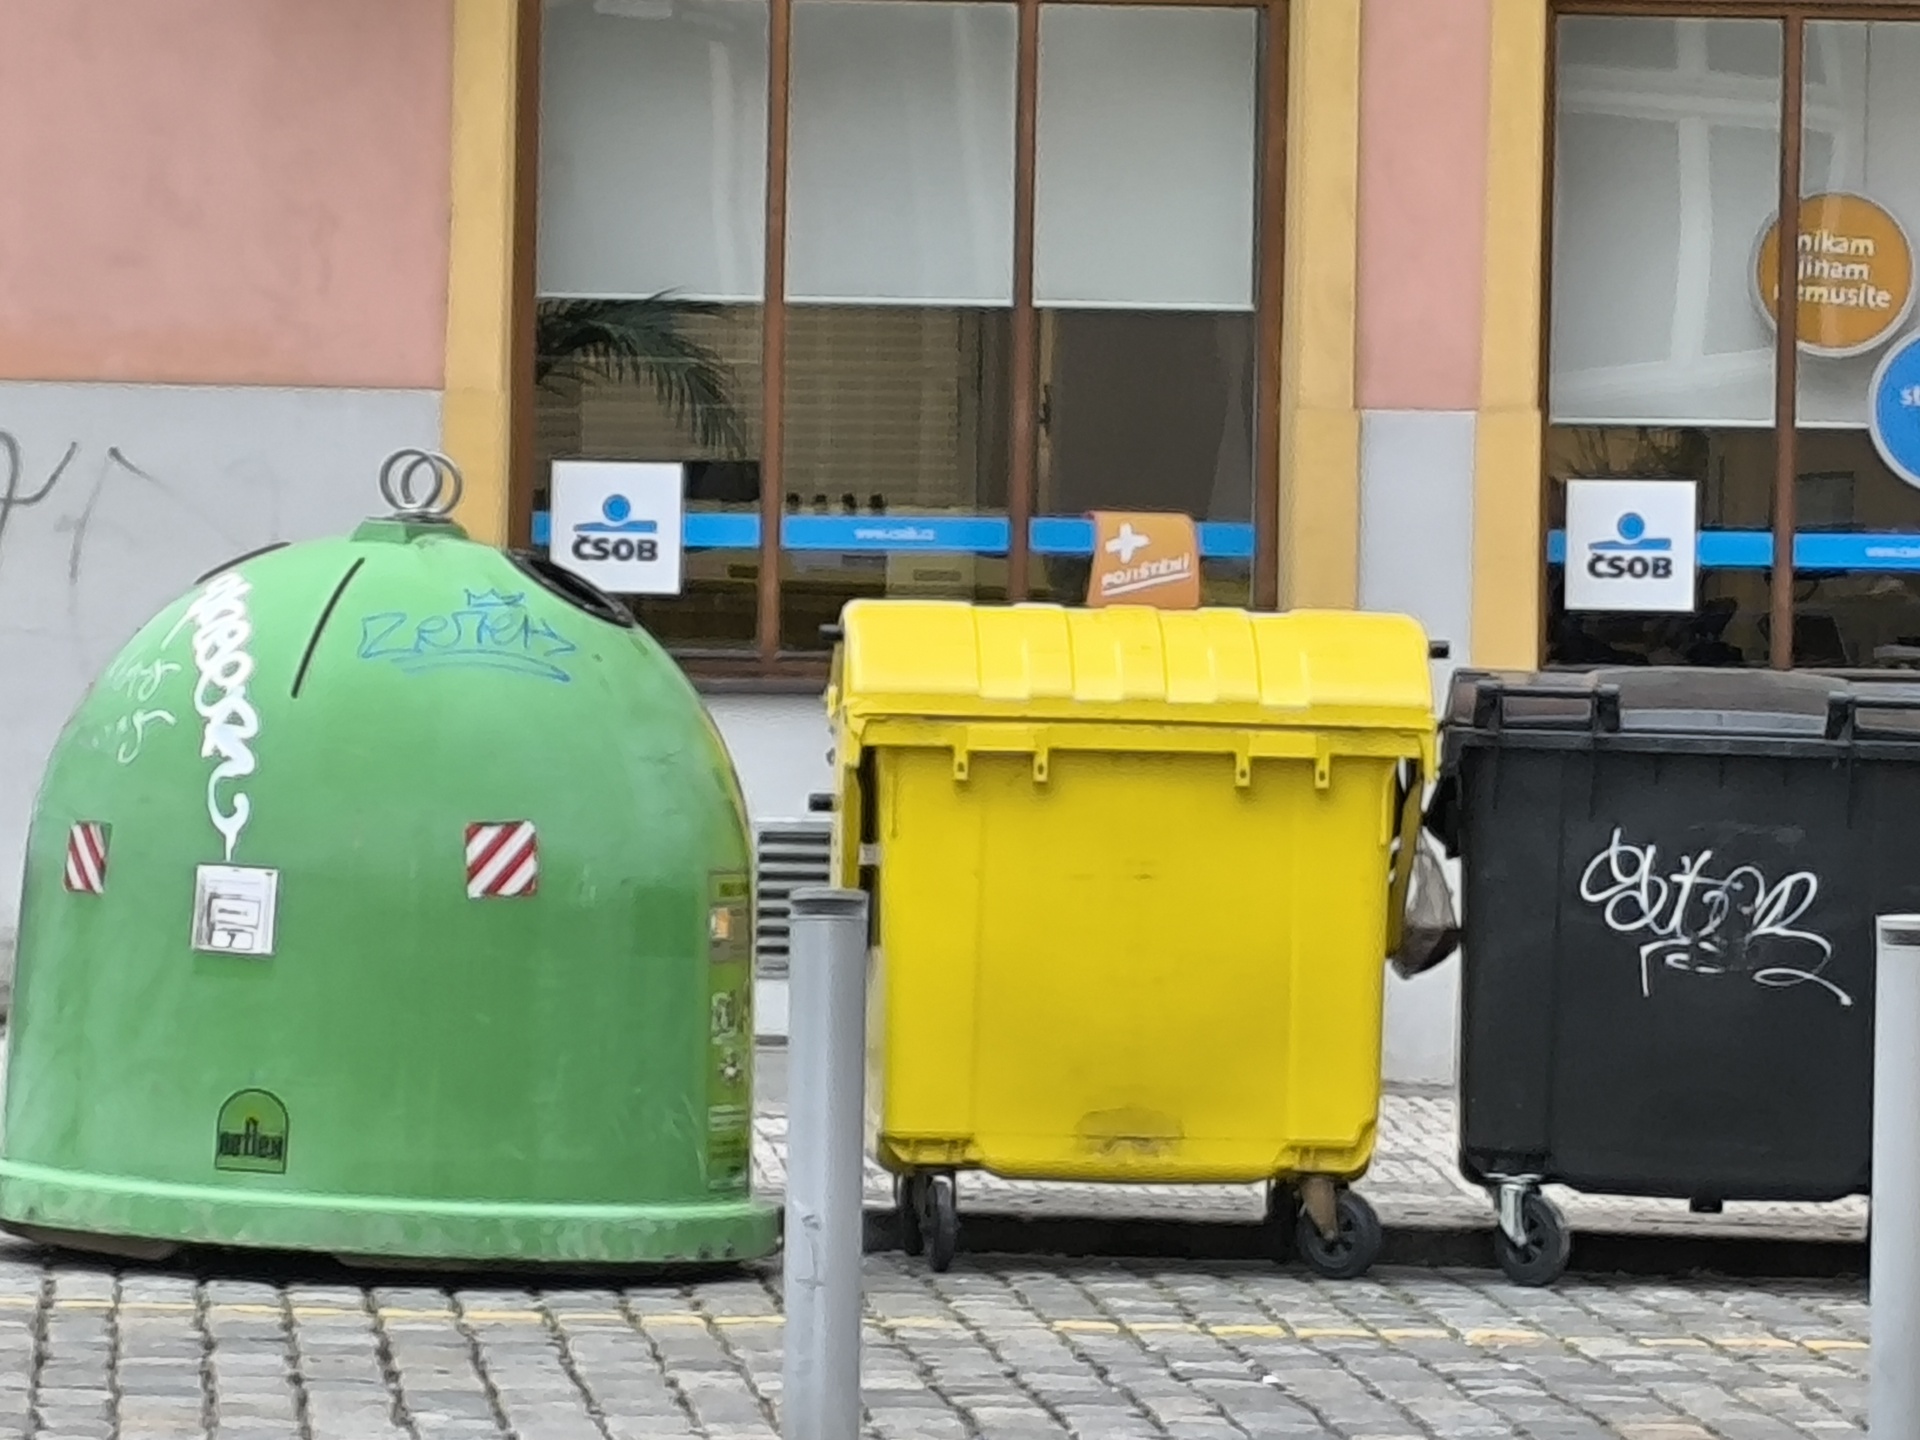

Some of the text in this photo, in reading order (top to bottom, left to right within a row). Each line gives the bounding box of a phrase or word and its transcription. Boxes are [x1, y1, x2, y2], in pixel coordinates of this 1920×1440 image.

[1797, 229, 1875, 256] nikam
[1797, 254, 1871, 281] jinam
[572, 534, 658, 561] ČSOB
[1587, 553, 1672, 579] ČSOB
